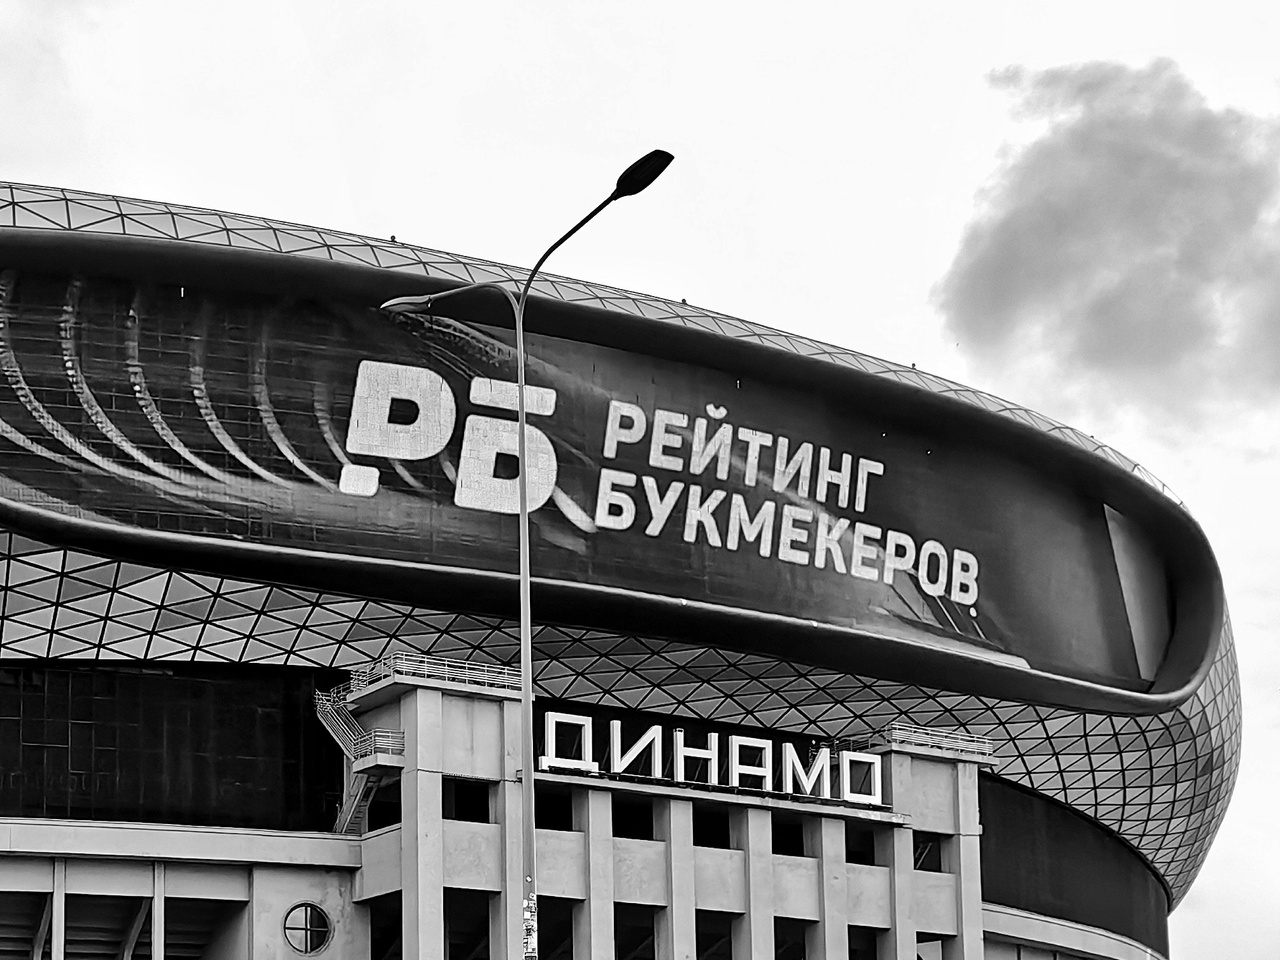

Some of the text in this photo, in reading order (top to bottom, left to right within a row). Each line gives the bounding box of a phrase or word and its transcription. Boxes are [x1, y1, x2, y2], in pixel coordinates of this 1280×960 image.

[602, 399, 885, 512] РЕЙТИНГ
[594, 468, 980, 608] БУКМЕКЕРОВ
[538, 711, 883, 805] ДИНАМО
